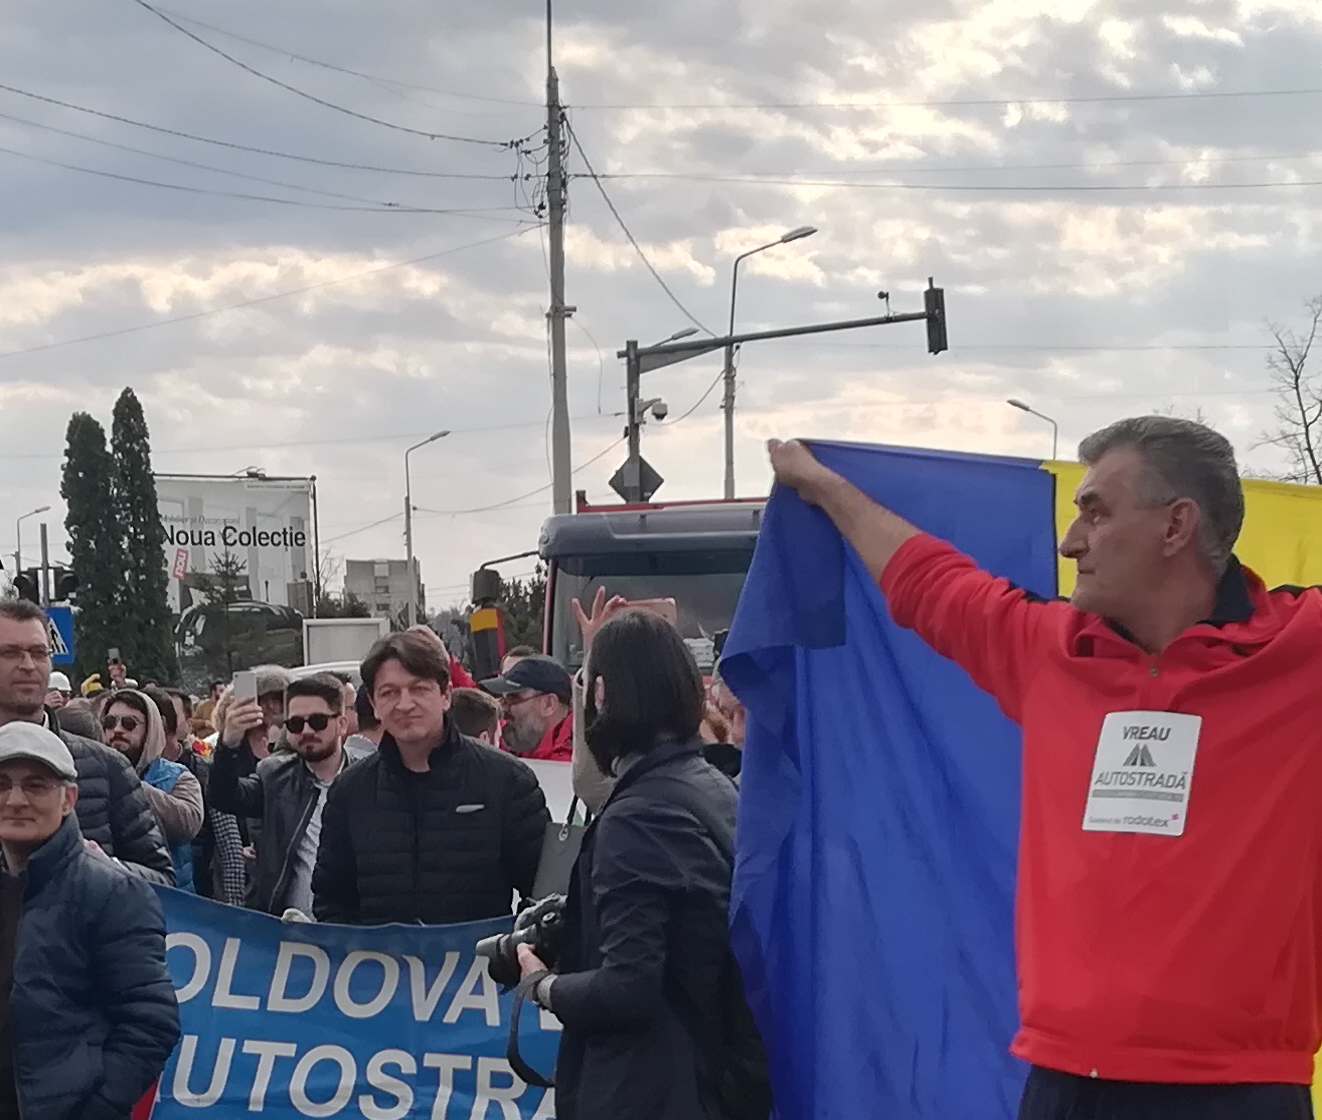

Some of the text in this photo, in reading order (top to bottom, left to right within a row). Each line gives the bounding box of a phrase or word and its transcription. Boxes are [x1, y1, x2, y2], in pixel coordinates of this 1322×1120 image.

[163, 525, 215, 546] Noua
[1123, 726, 1171, 741] VREAU
[1095, 771, 1189, 790] AUTOSTRADĂ
[165, 932, 501, 1027] OLDOVA
